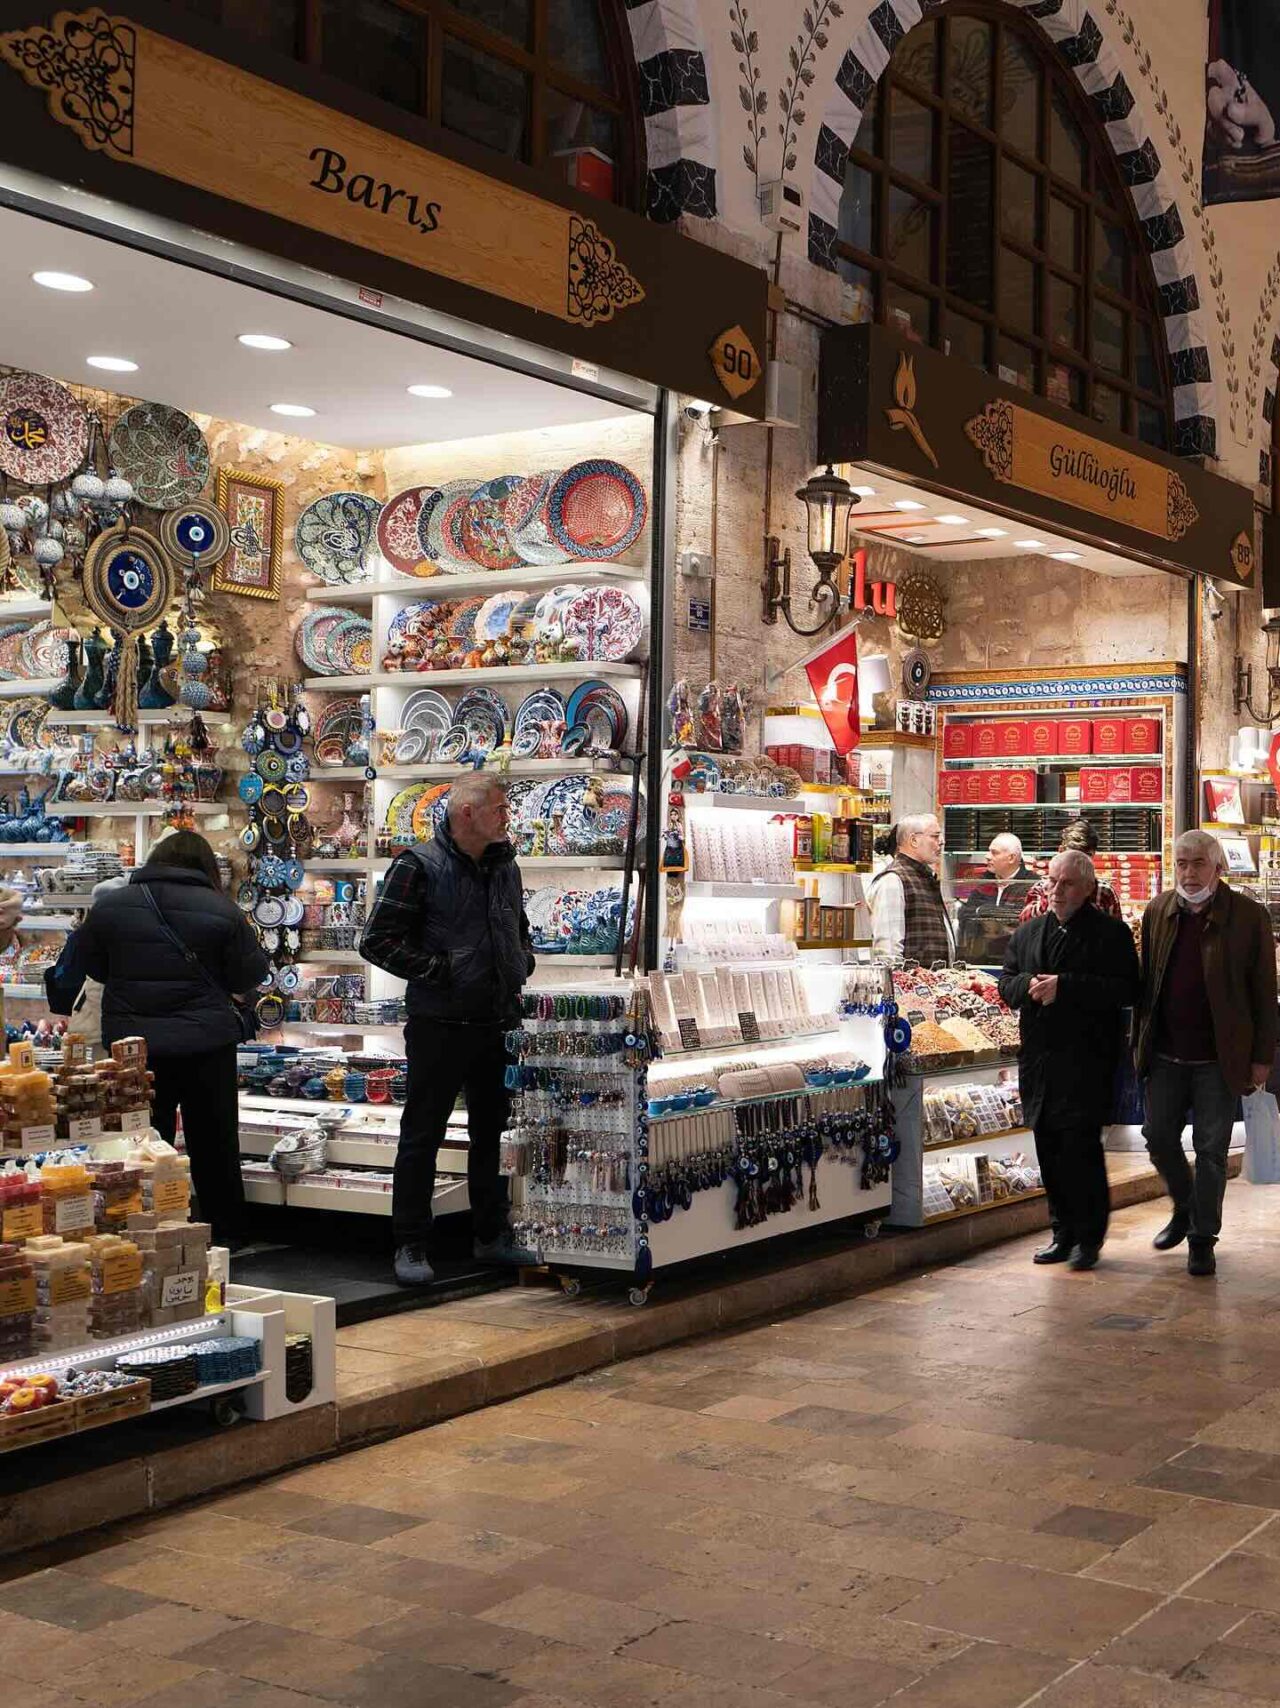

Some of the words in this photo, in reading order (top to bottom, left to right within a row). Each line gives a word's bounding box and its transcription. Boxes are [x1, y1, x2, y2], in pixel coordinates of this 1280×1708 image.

[309, 147, 441, 234] Barış
[723, 343, 751, 380] 90
[1050, 444, 1136, 501] Güllüoğlu
